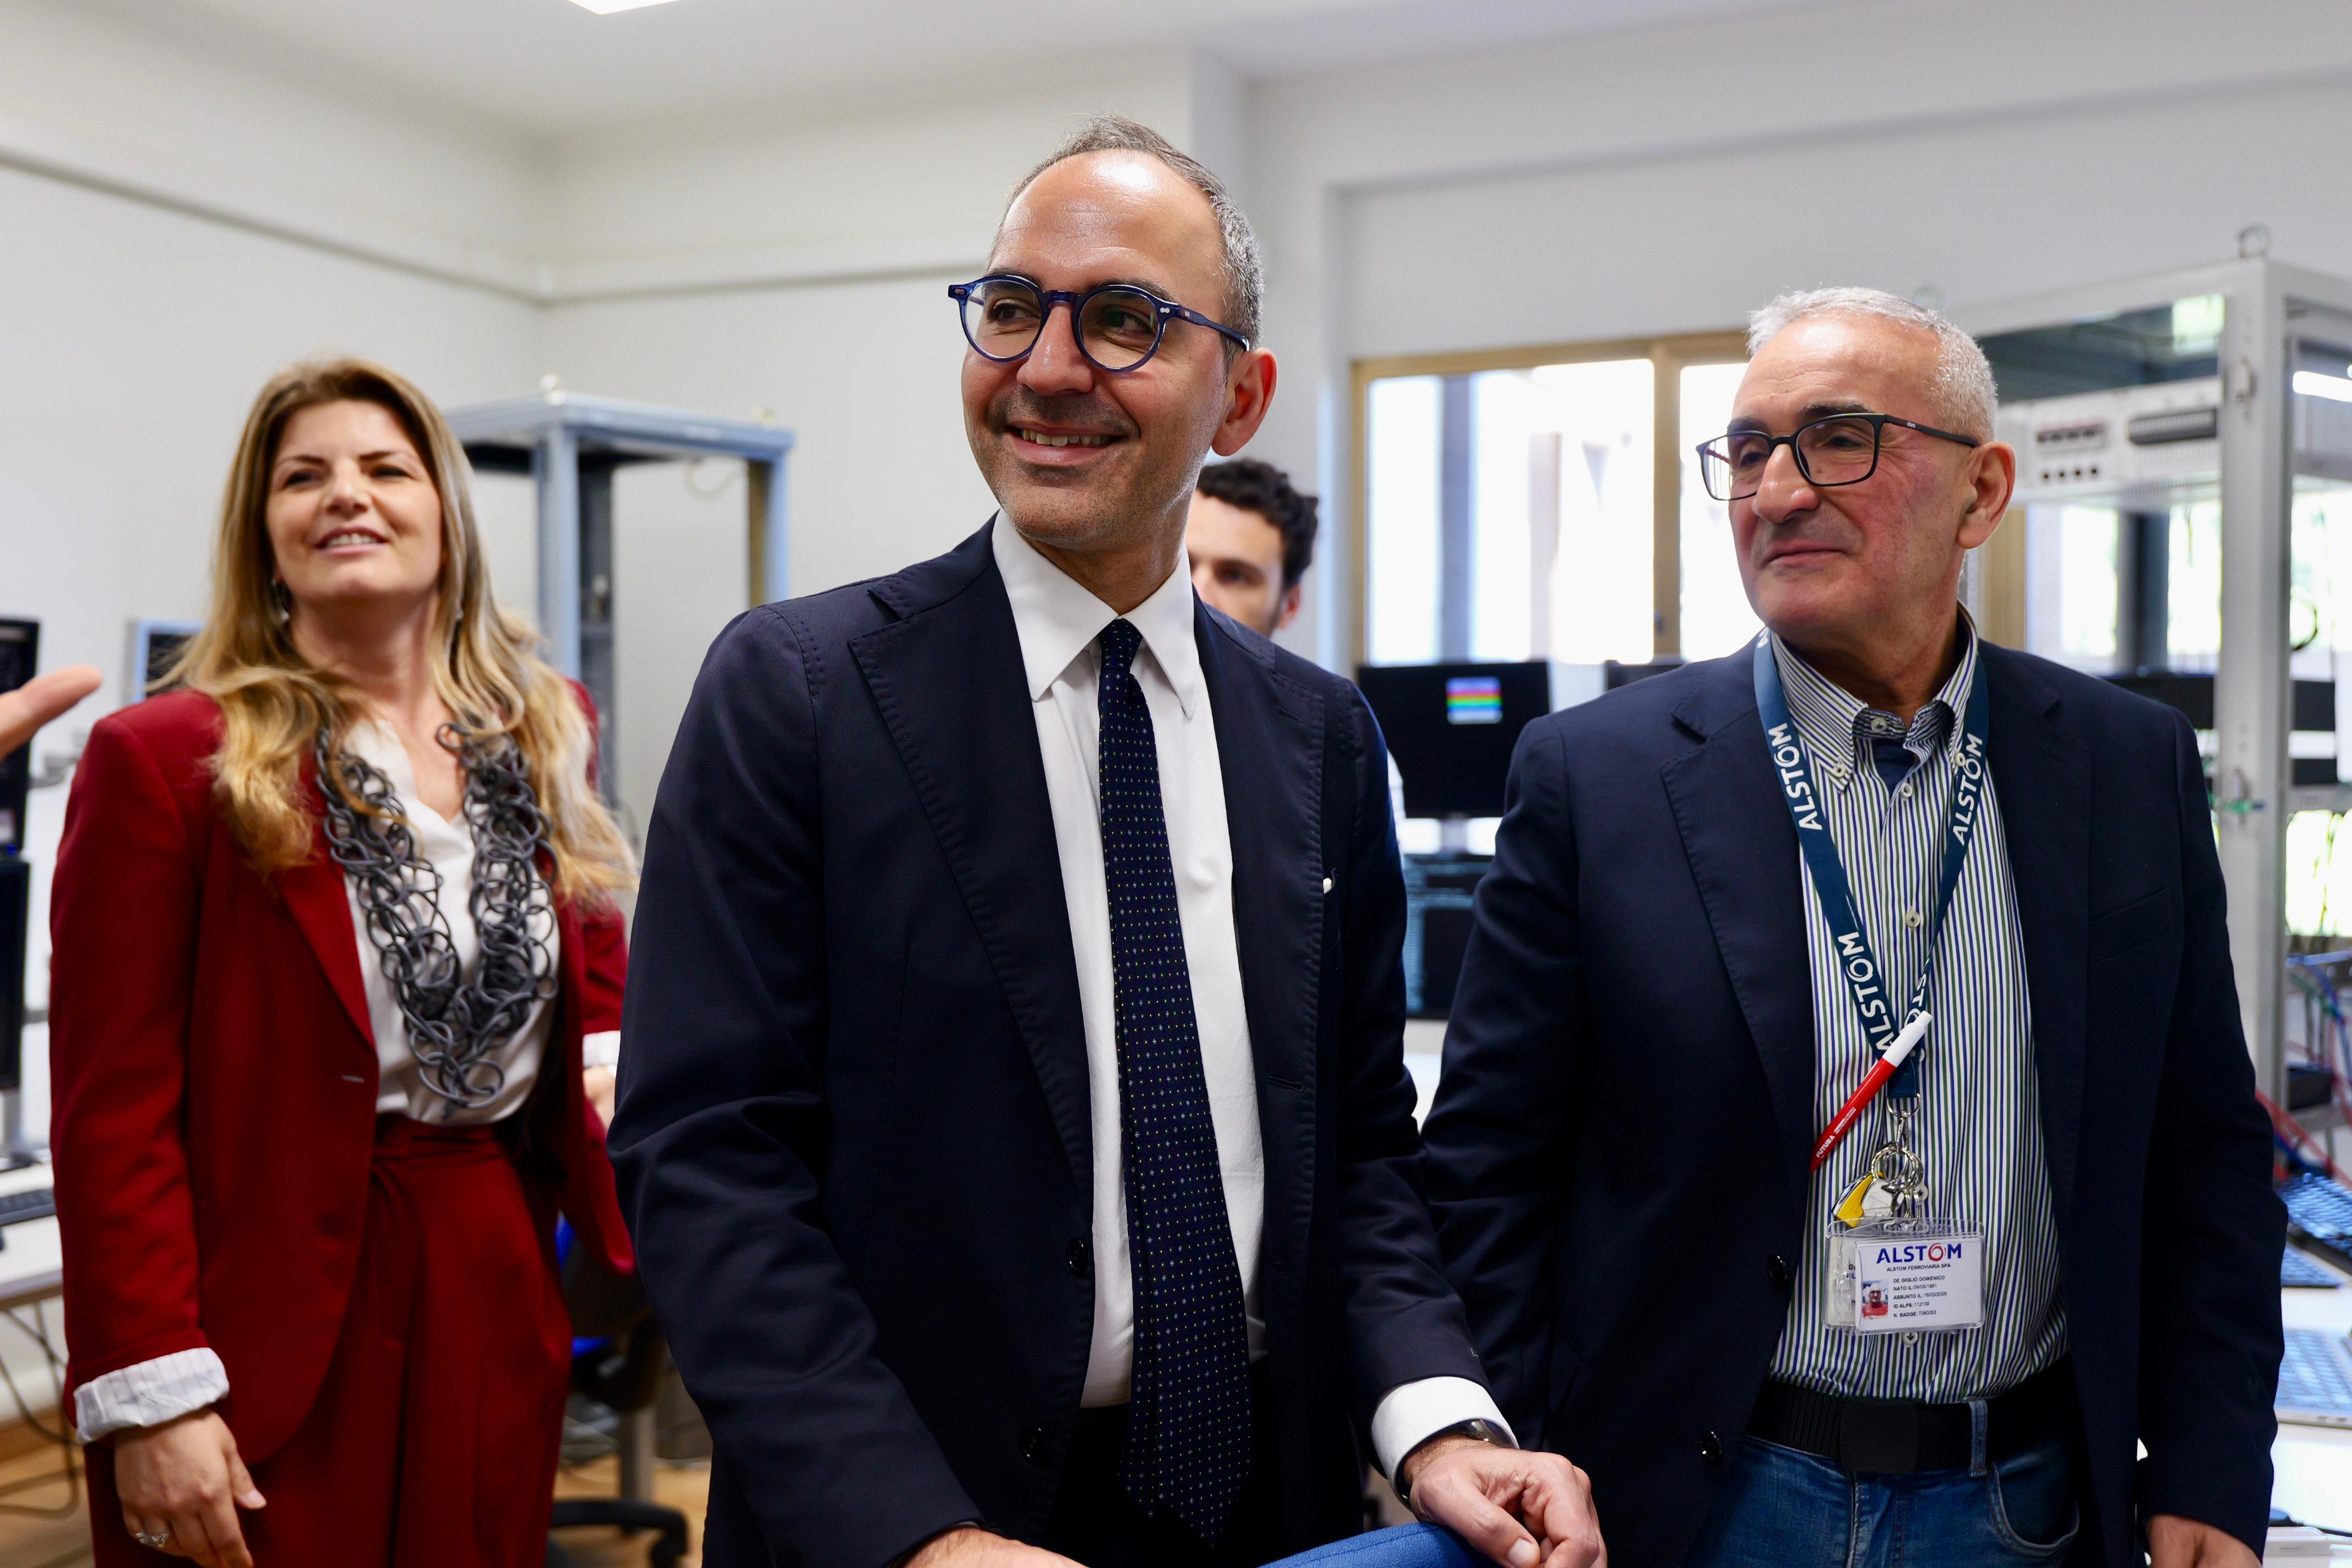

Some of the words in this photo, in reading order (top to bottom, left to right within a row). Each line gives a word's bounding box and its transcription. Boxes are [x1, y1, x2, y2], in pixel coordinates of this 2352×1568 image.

[1768, 722, 1823, 830] ALSTOM
[1952, 732, 1983, 846] ALSTOM
[1816, 1135, 1836, 1158] FUTURA
[1876, 1243, 1962, 1264] ALSTOM
